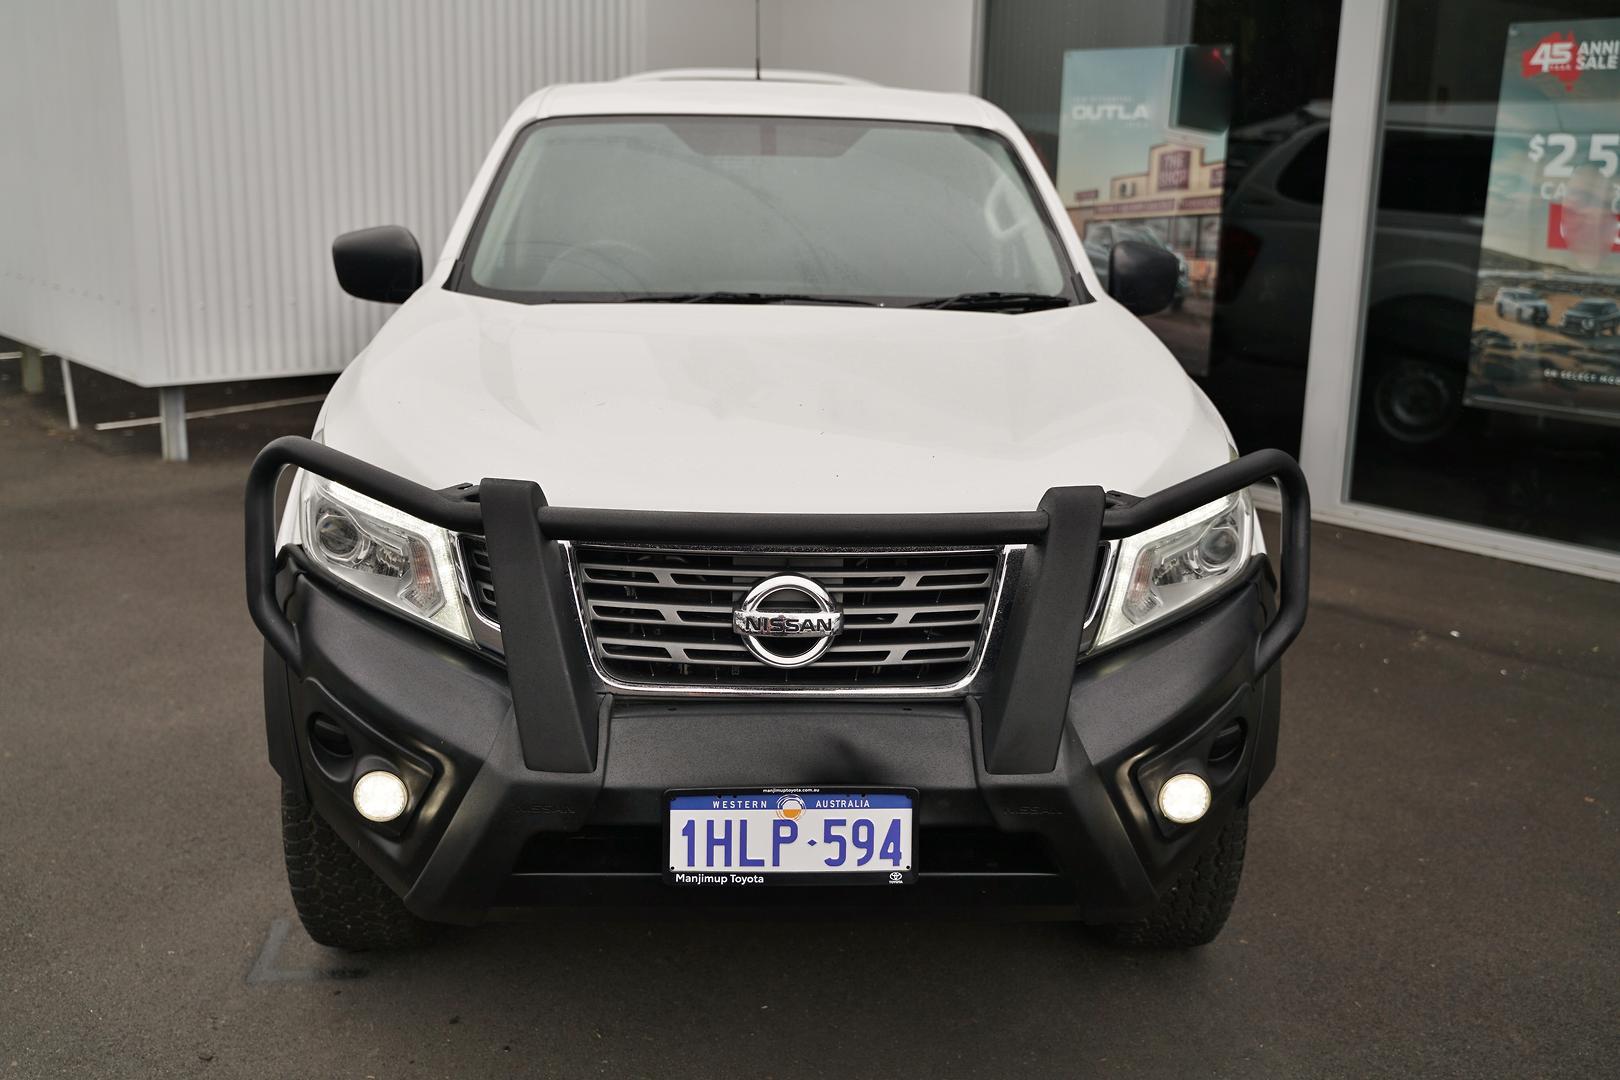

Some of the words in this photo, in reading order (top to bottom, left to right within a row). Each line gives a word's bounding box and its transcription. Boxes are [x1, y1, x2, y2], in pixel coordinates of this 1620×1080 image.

[1529, 43, 1573, 72] 45
[1576, 55, 1618, 70] SALE
[745, 617, 832, 632] NISSAN
[712, 800, 768, 809] WESTERN
[815, 799, 870, 808] AUSTRALIA
[675, 873, 728, 885] Manjimup
[730, 874, 765, 886] Toyota
